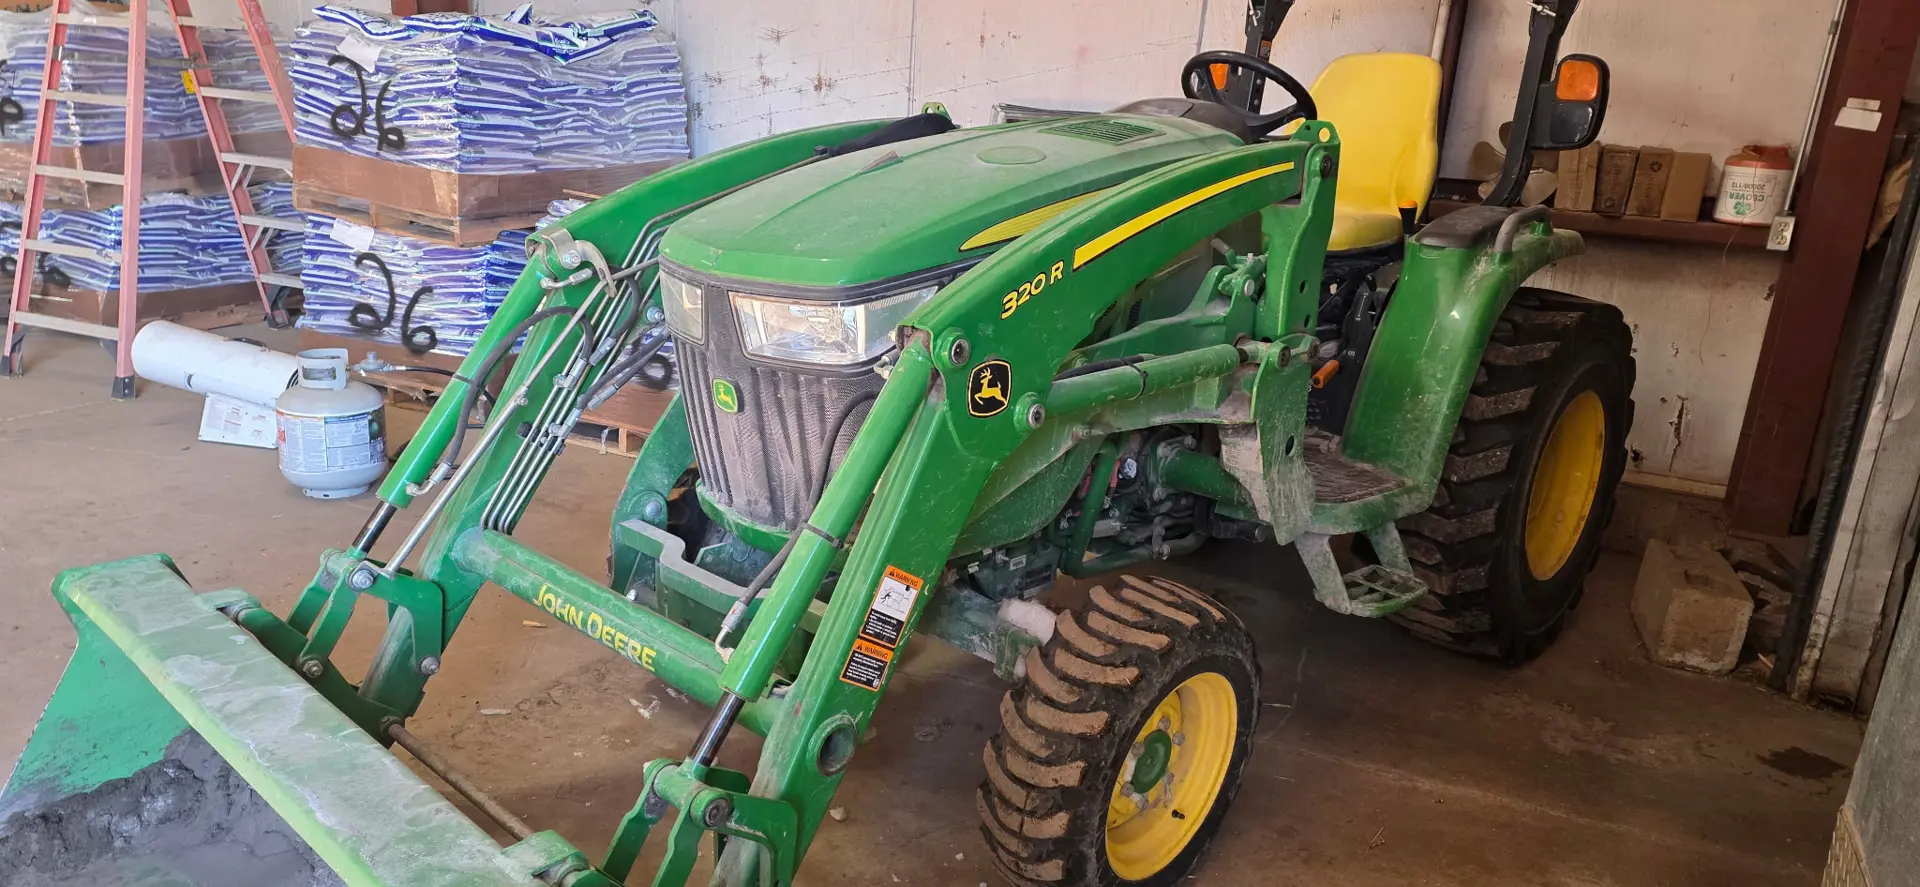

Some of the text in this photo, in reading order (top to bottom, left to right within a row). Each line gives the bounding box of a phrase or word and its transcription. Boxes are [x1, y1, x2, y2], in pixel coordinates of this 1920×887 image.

[1728, 192, 1765, 202] CLOVER
[347, 252, 438, 354] 26
[1001, 259, 1065, 320] 320 R
[895, 573, 919, 587] WARNING
[533, 584, 657, 672] JOHN DEERE
[864, 646, 889, 660] WARNING
